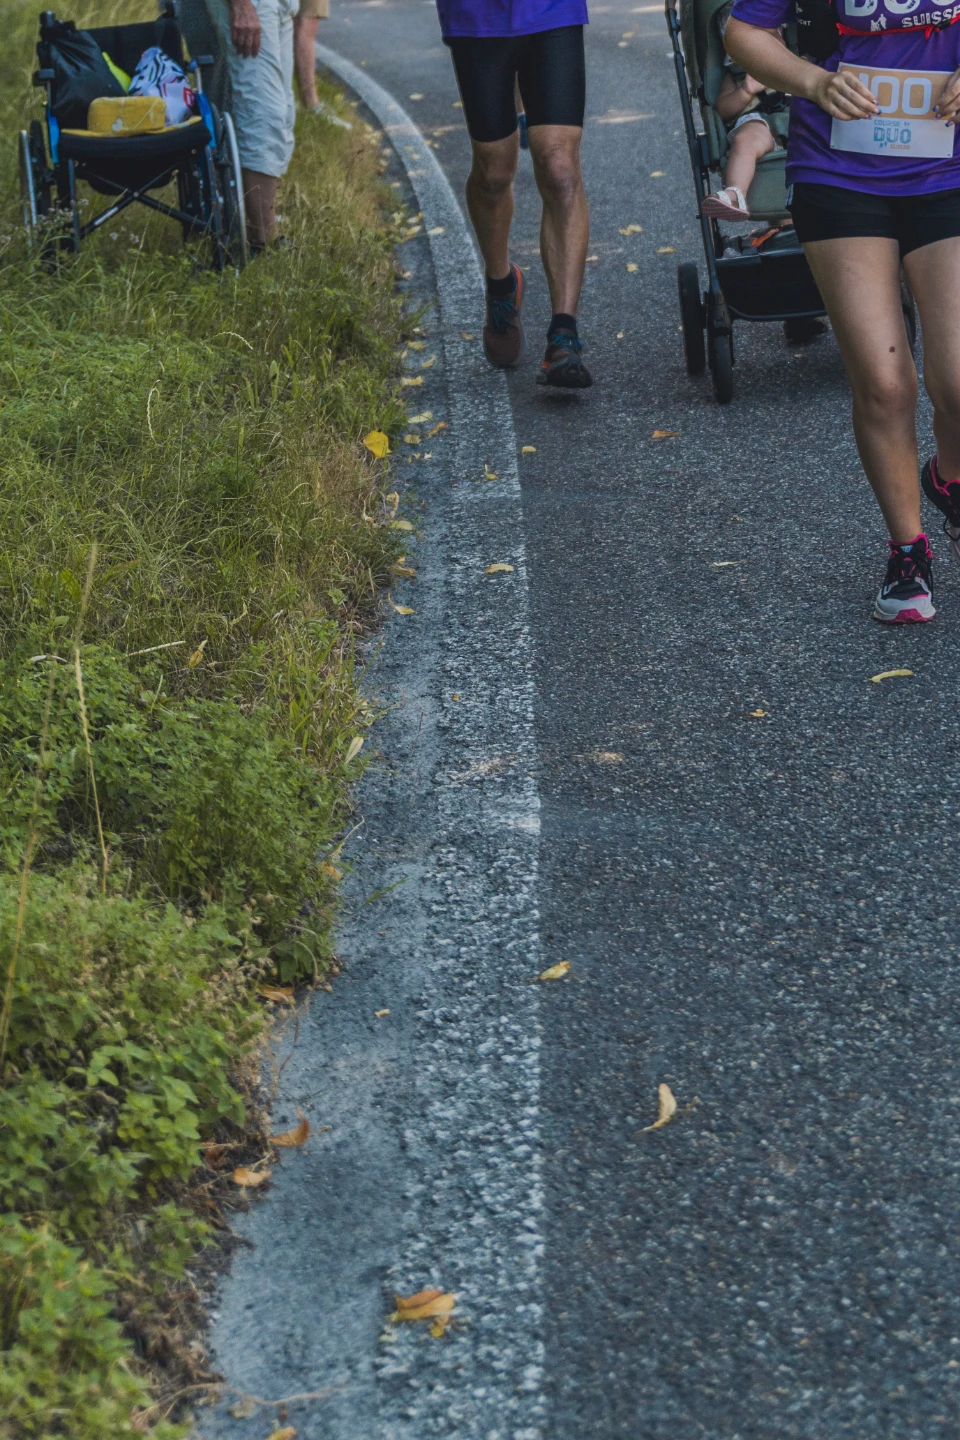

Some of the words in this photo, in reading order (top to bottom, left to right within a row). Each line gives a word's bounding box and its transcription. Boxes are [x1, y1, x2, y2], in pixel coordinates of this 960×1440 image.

[858, 73, 932, 116] 100
[873, 126, 912, 145] DUO
[890, 143, 911, 151] SUISSE
